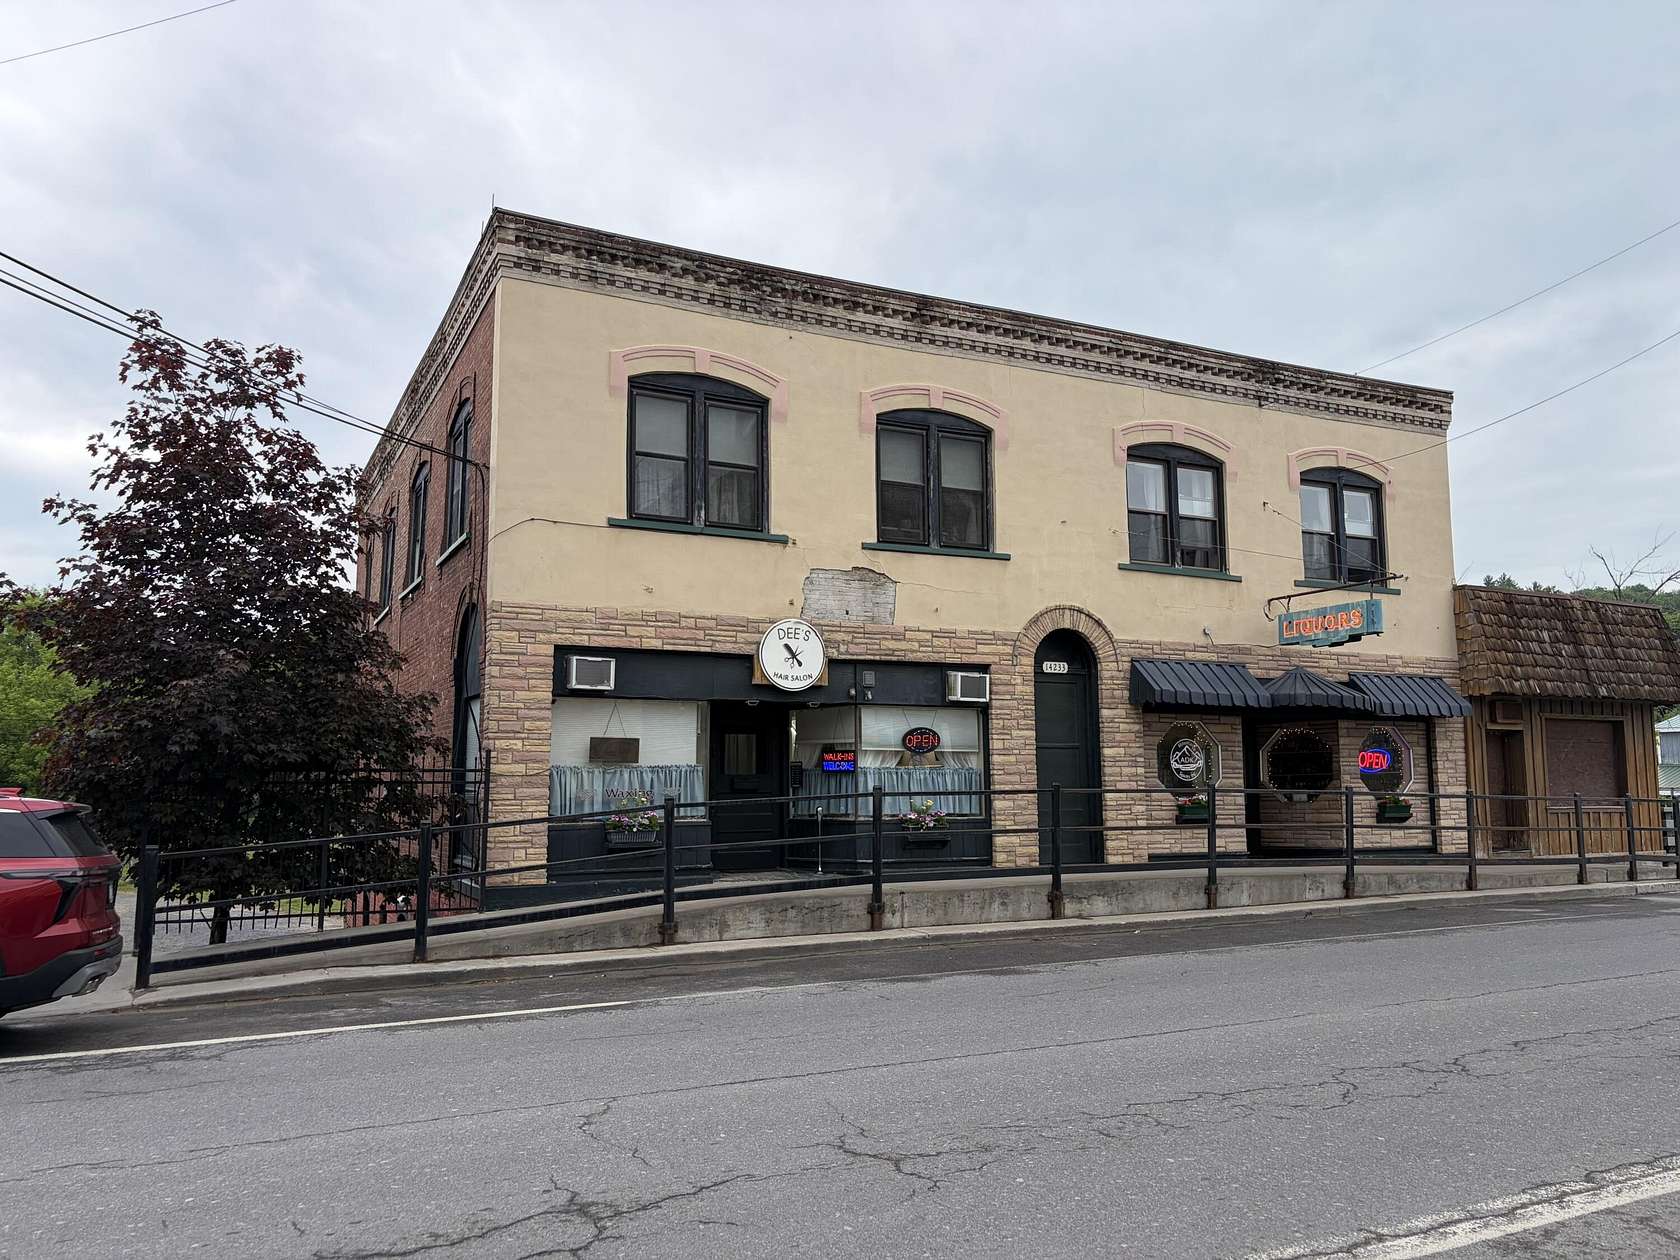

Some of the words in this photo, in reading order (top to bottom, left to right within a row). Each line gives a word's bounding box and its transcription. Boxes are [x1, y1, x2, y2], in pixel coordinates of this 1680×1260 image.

[1283, 608, 1363, 638] LIQUORS
[777, 626, 811, 642] DEE'S
[1045, 663, 1066, 672] 14233
[773, 671, 789, 681] HAIR
[791, 672, 813, 682] SALON
[905, 734, 938, 747] OPEN
[823, 752, 855, 761] WALK-INS
[1180, 756, 1195, 764] ADK
[1358, 751, 1388, 769] OPEN
[823, 761, 855, 771] WELCOME
